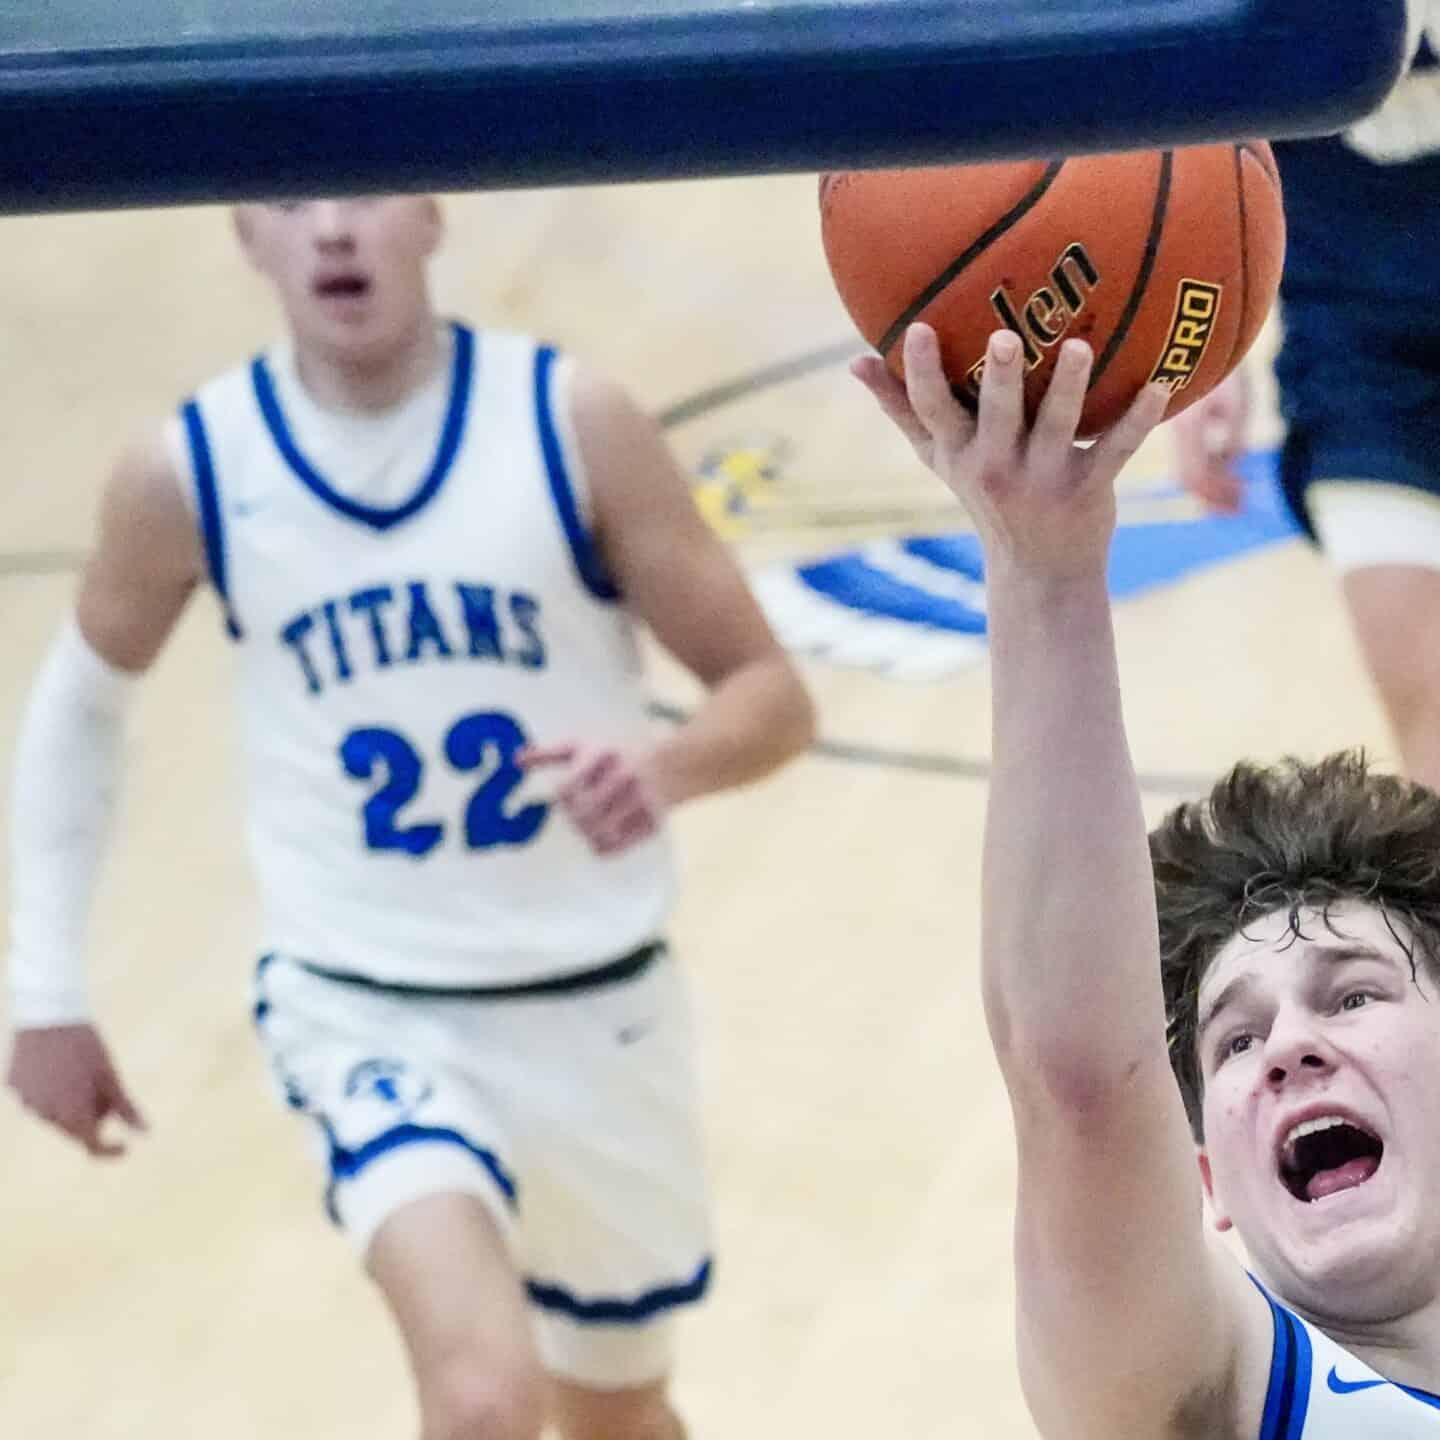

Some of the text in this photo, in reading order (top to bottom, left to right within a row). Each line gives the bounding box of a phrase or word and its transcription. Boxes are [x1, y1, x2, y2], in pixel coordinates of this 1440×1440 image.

[1162, 288, 1215, 372] PRO
[280, 581, 547, 695] TITANS
[338, 709, 552, 857] 22
